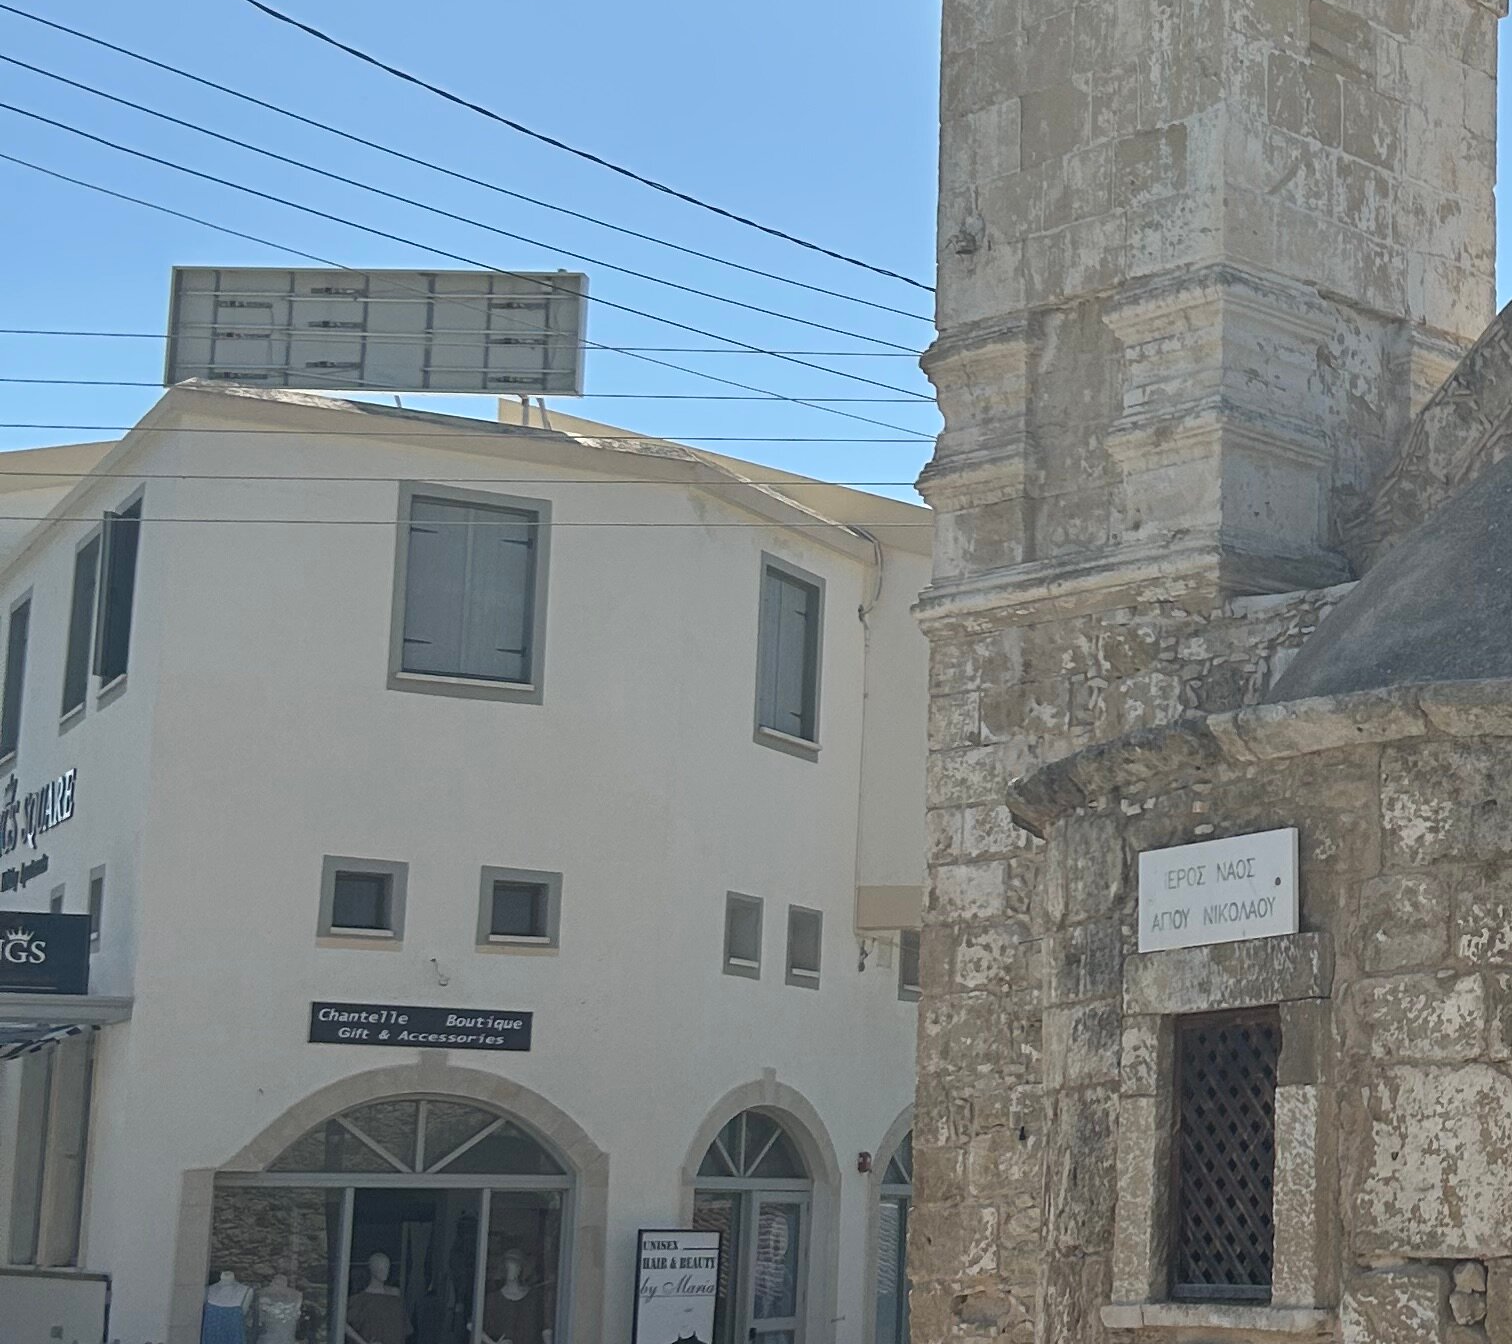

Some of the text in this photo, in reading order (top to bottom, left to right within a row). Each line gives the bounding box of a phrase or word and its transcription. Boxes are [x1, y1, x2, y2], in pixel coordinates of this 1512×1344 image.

[21, 767, 77, 850] SQUARE
[1216, 857, 1256, 883] ΝΑΟΣ
[1151, 896, 1276, 932] ΑΓΙΟΥ ΝΙΚΟΛΑΟΥ
[318, 1008, 523, 1030] Chantelle Boutique
[338, 1027, 504, 1045] Gift & Accessories
[643, 1240, 679, 1251] UNISEX
[642, 1256, 715, 1270] HAIR & BEAUTY
[640, 1276, 658, 1304] by
